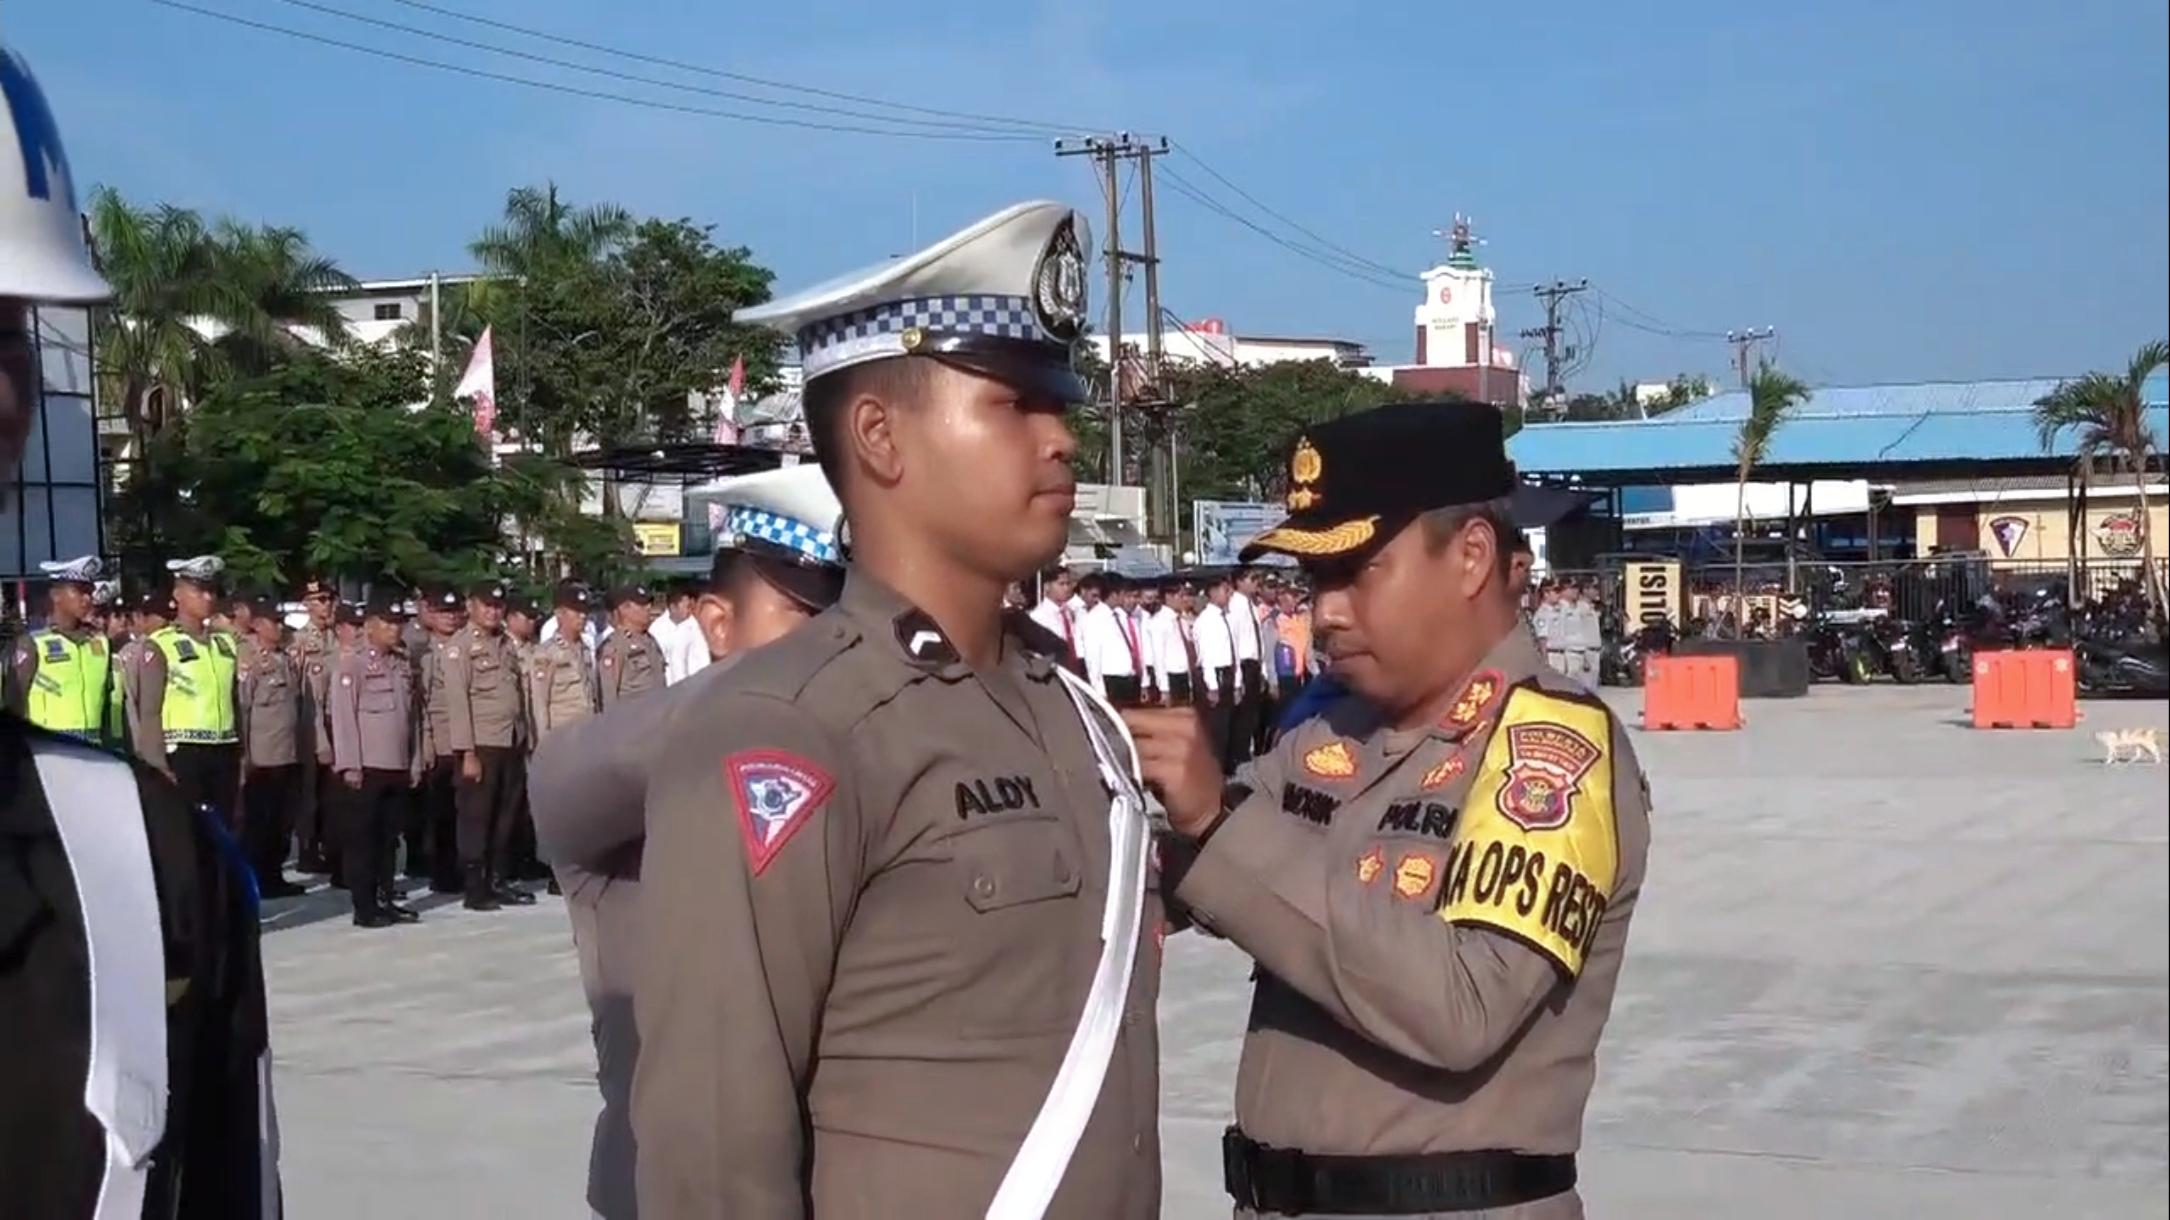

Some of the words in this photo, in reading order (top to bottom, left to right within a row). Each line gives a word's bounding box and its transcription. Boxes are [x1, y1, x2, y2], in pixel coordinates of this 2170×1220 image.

[1640, 566, 1666, 624] OLISI
[955, 776, 1040, 820] ALDY
[1473, 841, 1545, 917] OPS
